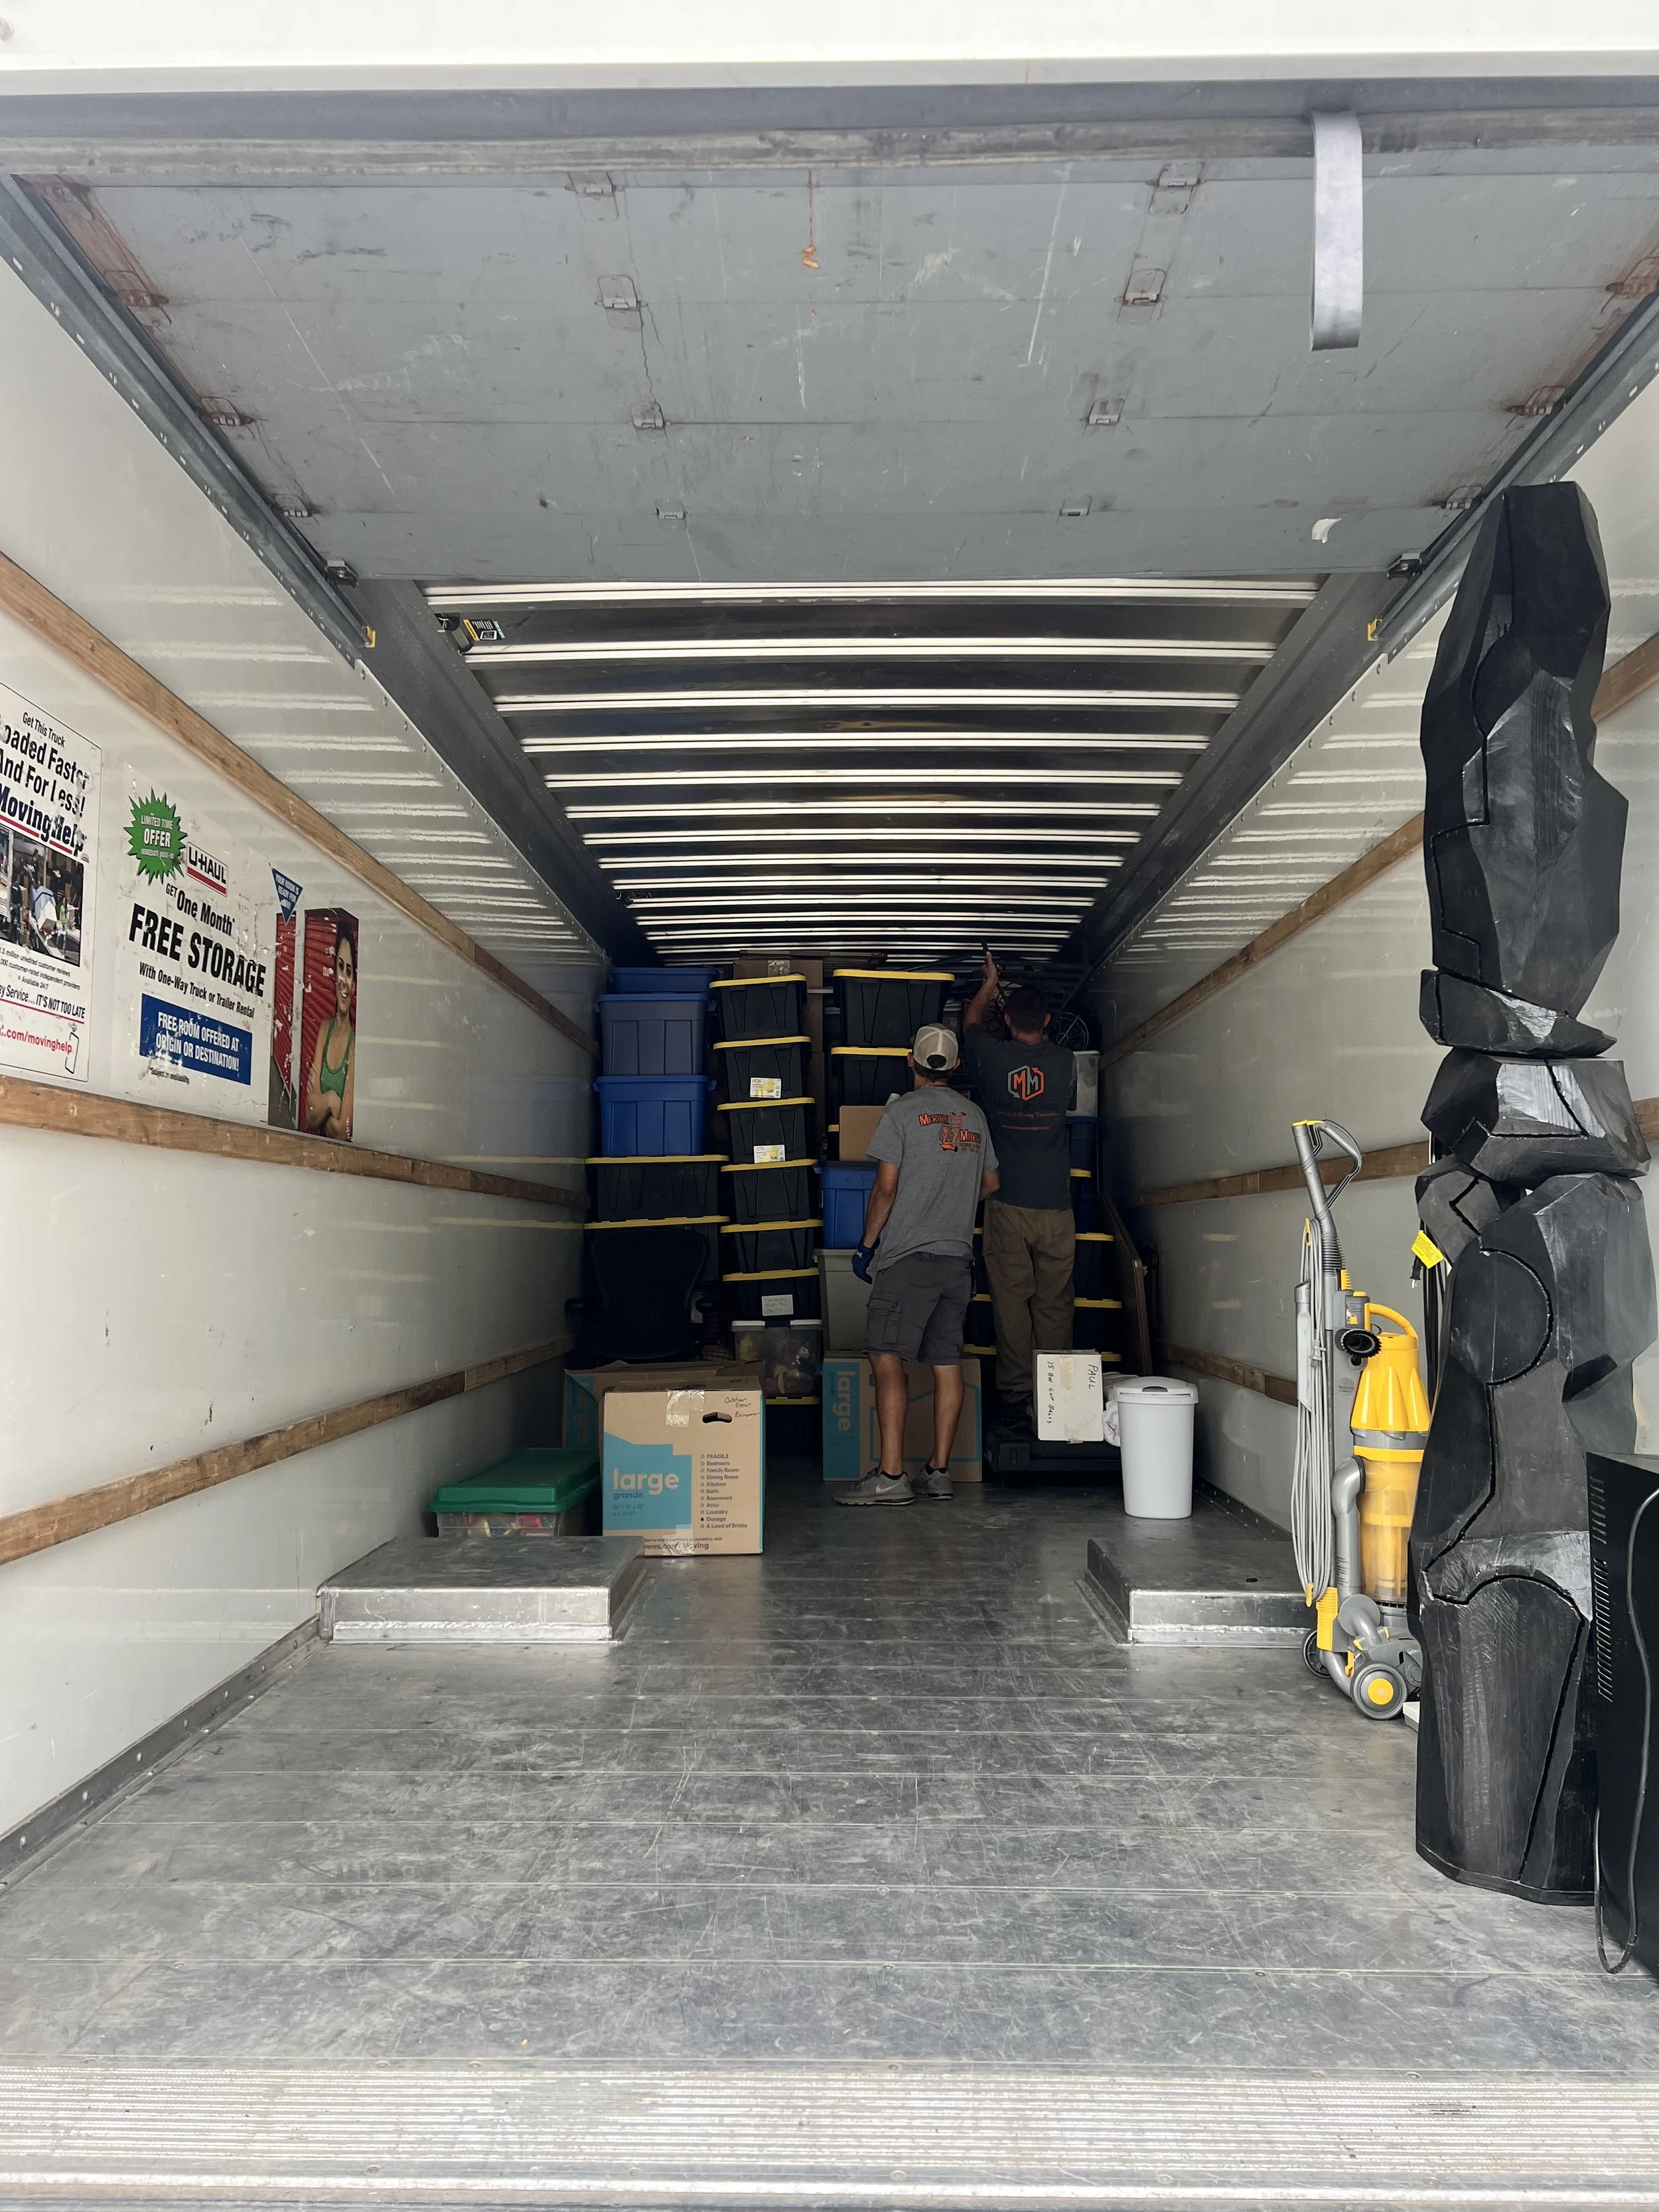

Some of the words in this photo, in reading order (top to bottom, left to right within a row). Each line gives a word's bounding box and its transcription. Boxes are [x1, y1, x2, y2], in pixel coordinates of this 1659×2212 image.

[23, 712, 34, 728] Get
[35, 719, 47, 737] This
[48, 728, 65, 748] Truck
[0, 724, 47, 765] oaded
[25, 764, 49, 798] For
[141, 814, 161, 827] LIMITED
[161, 818, 173, 830] TIME
[143, 828, 171, 848] OFFER
[188, 846, 226, 885] U-HAUL
[166, 883, 178, 898] GET
[177, 890, 198, 918] One
[6, 950, 20, 960] million
[21, 956, 38, 966] unedited
[38, 961, 56, 972] customer
[56, 967, 70, 978] reviews
[129, 903, 184, 962] FREE
[188, 932, 267, 997] STORAGE
[21, 977, 39, 988] Available
[40, 970, 63, 985] independent
[63, 979, 80, 990] providers
[139, 961, 156, 980] With
[158, 970, 188, 994] One-Way
[190, 982, 207, 1000] Truck
[208, 992, 215, 1002] or
[216, 993, 236, 1011] Trailer
[236, 1001, 255, 1019] Rental
[36, 994, 48, 1008] IT'S
[48, 997, 60, 1011] NOT
[60, 1001, 72, 1014] TOO
[72, 1003, 86, 1019] LATE
[158, 1011, 178, 1031] FREE
[179, 1018, 200, 1039] ROOM
[201, 1027, 230, 1049] OFFERED
[231, 1037, 240, 1052] AT
[156, 1033, 182, 1055] ORIGIN
[183, 1041, 194, 1058] OR
[194, 1045, 240, 1072] DESTINATION!
[1047, 1361, 1054, 1370] 15
[1088, 1364, 1099, 1390] PAUL
[832, 1370, 856, 1432] large
[613, 1468, 680, 1496] large
[613, 1491, 644, 1501] grande
